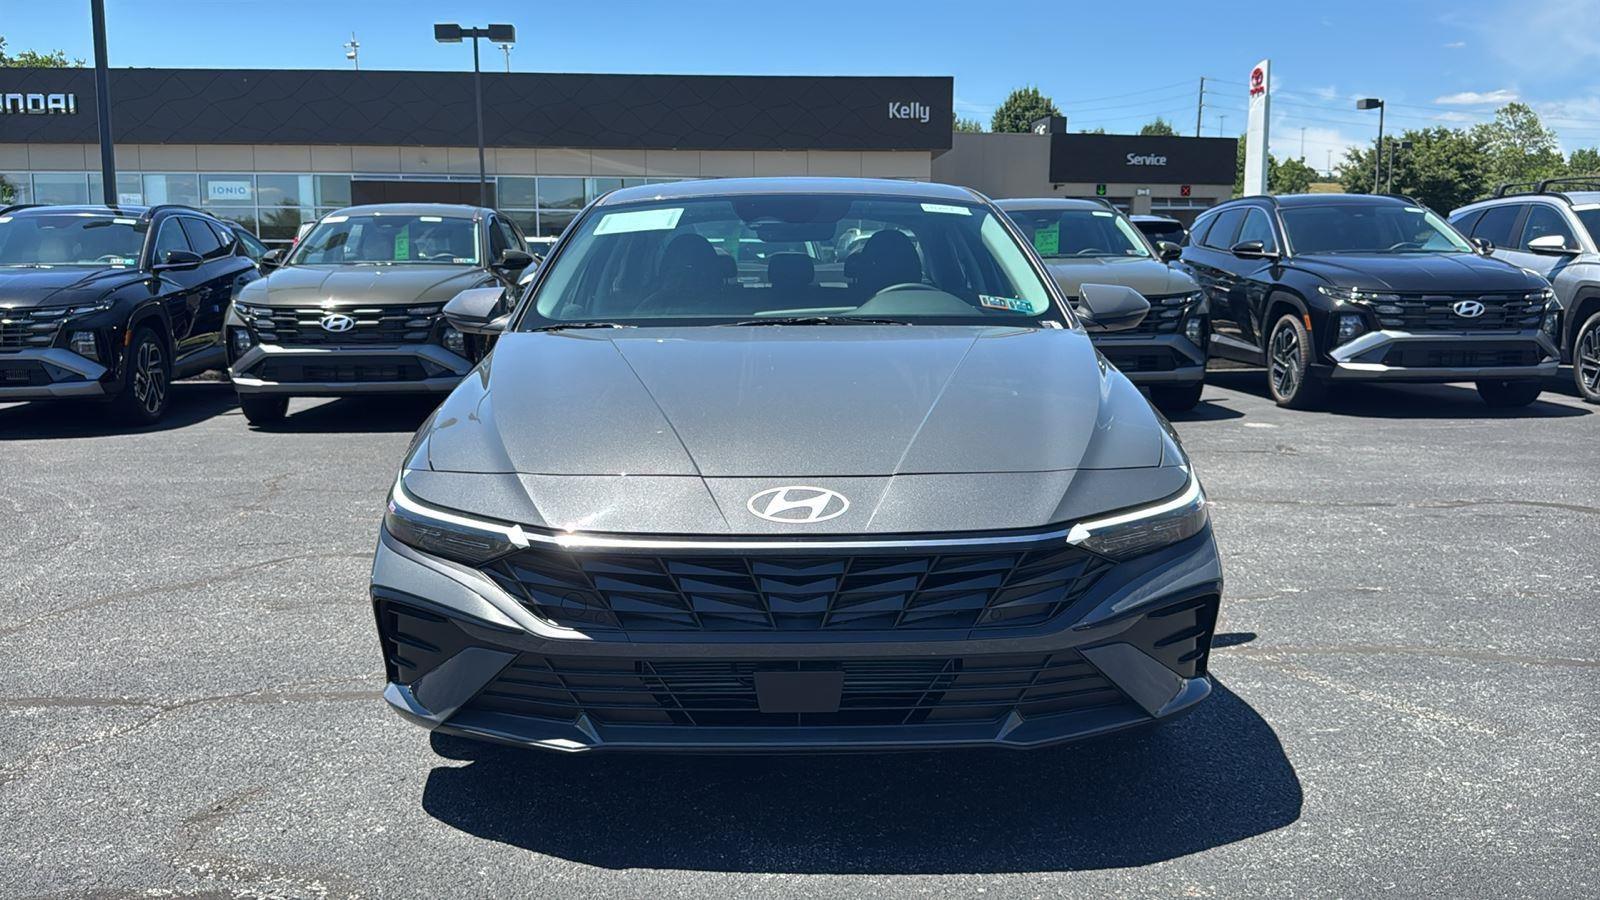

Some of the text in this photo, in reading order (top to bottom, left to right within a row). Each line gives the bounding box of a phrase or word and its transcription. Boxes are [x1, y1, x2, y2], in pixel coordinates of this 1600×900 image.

[0, 93, 76, 114] NDAI
[888, 101, 930, 123] Kelly
[1126, 152, 1167, 166] Service
